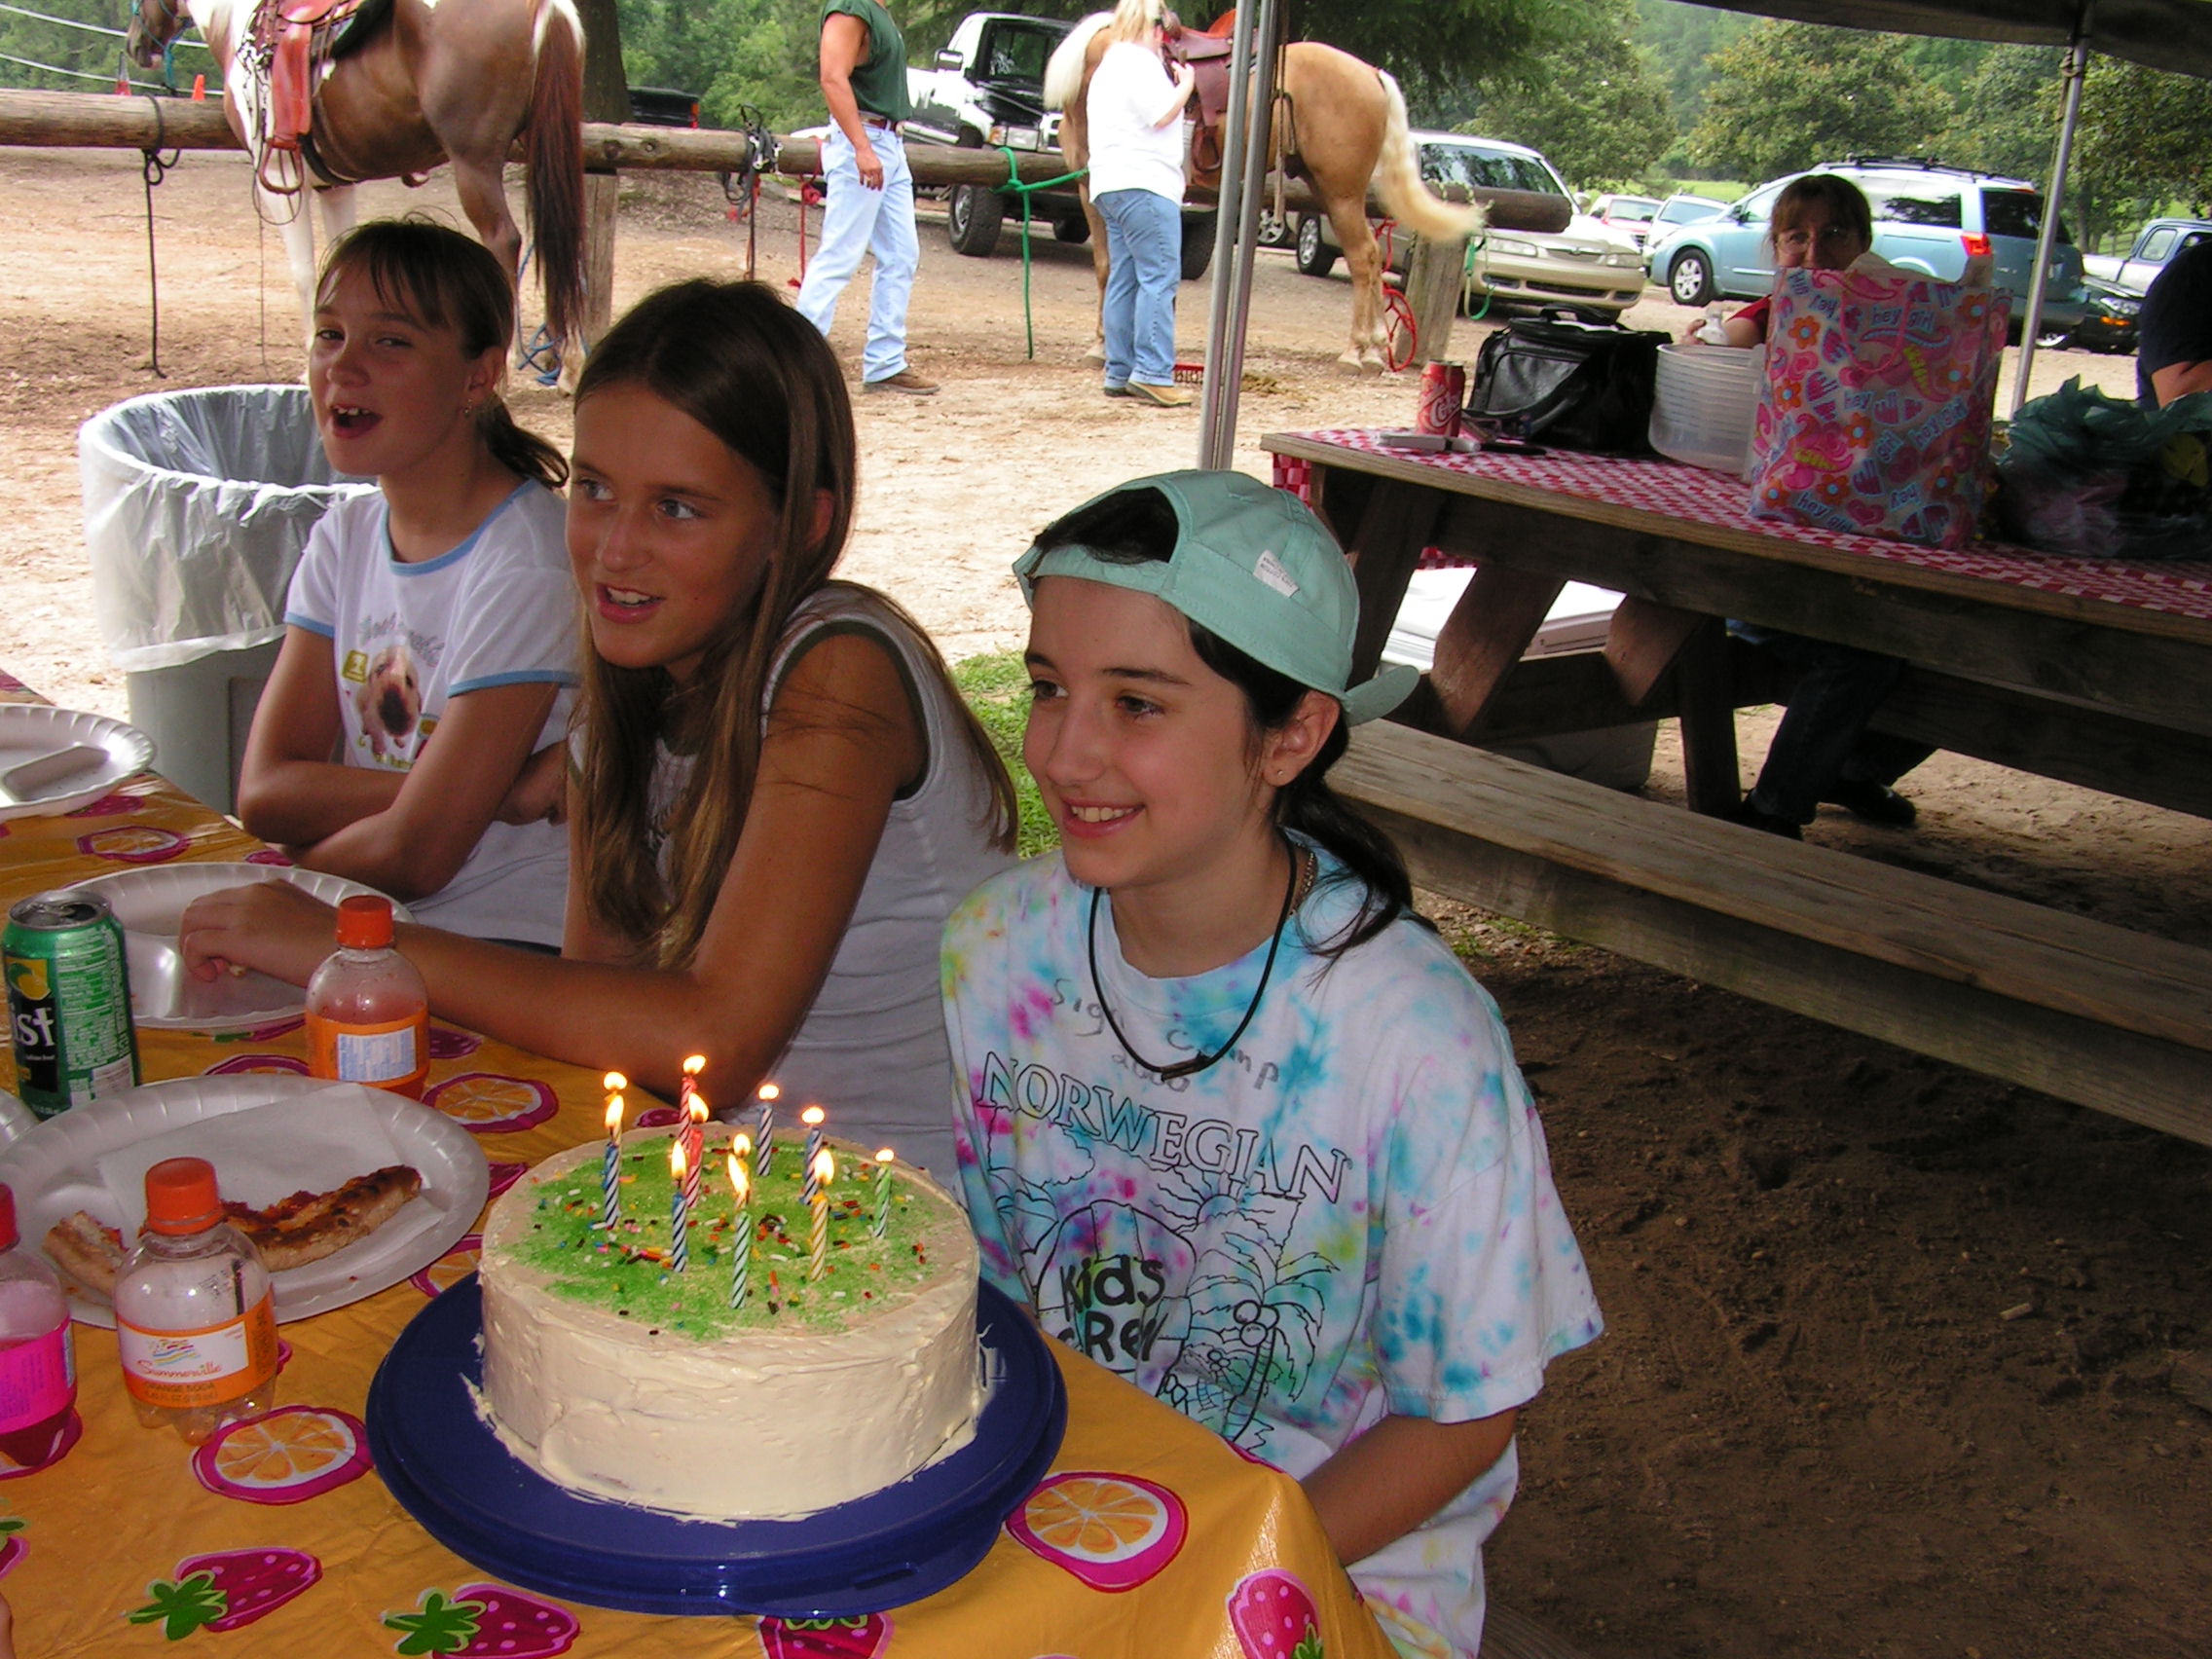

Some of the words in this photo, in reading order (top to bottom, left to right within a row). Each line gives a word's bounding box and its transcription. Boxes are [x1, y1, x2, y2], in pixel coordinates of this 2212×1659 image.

[1869, 304, 1903, 326] hey
[1908, 308, 1935, 331] girl
[1797, 491, 1830, 517] hey
[1826, 514, 1854, 532] gir
[977, 1051, 1353, 1204] NORWEGIAN
